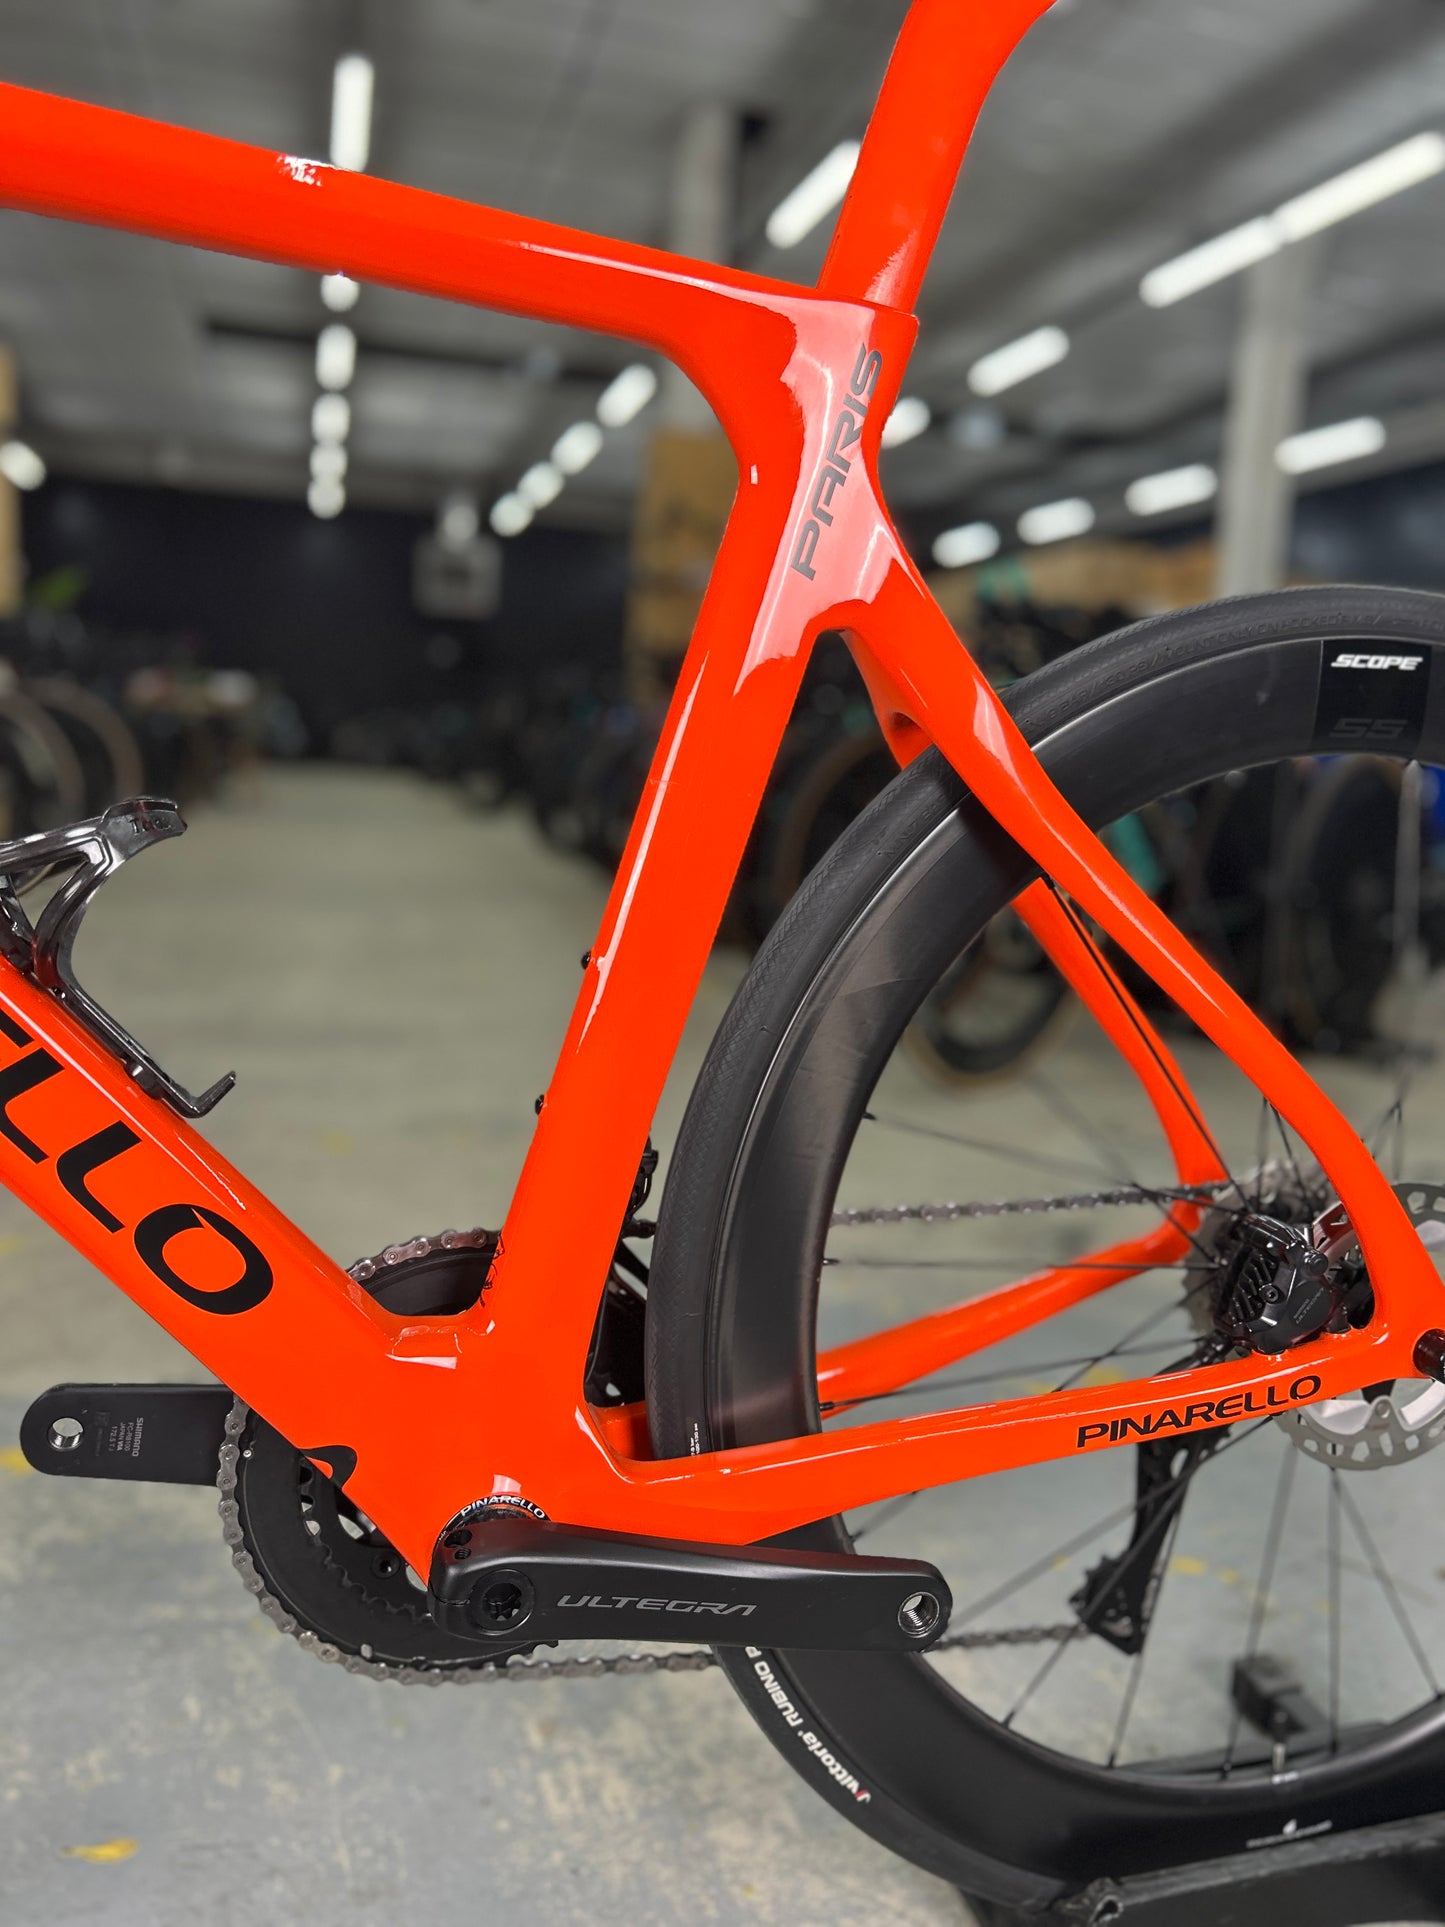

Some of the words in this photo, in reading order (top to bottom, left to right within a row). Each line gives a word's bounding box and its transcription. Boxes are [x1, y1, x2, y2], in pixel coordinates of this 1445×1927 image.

[791, 343, 882, 581] PARIS
[1330, 653, 1424, 671] SCOPE
[1077, 1375, 1322, 1448] PINARELLO
[132, 1417, 143, 1456] SHIMANO
[460, 1495, 546, 1519] PINARELLO
[557, 1595, 758, 1616] ULTEGRA
[745, 1646, 762, 1659] P
[754, 1661, 804, 1727] RUBINO
